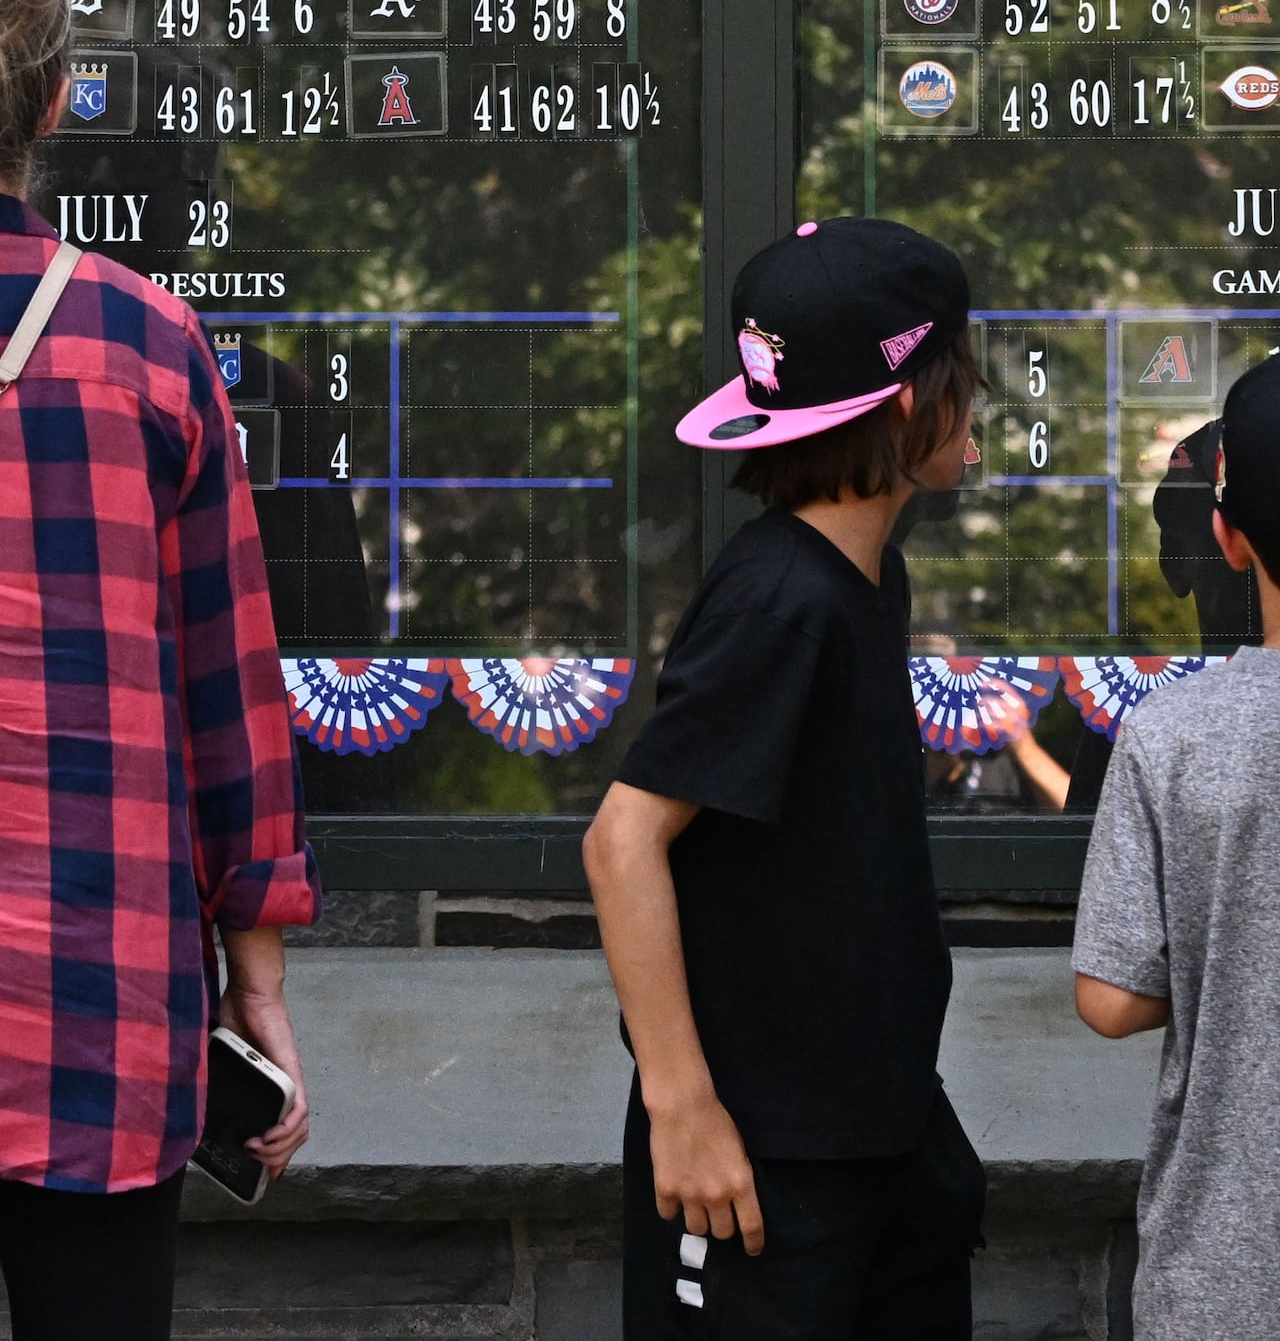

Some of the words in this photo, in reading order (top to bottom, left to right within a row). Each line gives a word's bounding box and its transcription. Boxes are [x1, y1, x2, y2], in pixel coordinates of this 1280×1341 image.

[909, 5, 953, 21] NATIONALS
[74, 83, 103, 110] KC
[157, 85, 199, 133] 43
[215, 86, 257, 134] 61
[473, 85, 516, 132] 41
[532, 84, 575, 133] 62
[908, 81, 947, 101] Mets
[1002, 82, 1049, 132] 43
[1069, 78, 1110, 127] 60
[1236, 82, 1280, 94] REDS
[54, 195, 148, 243] JULY
[188, 200, 229, 248] 23
[149, 272, 285, 298] RESULTS
[330, 354, 348, 401] 3
[1028, 350, 1047, 398] 5
[330, 433, 349, 479] 4
[1028, 421, 1048, 468] 6
